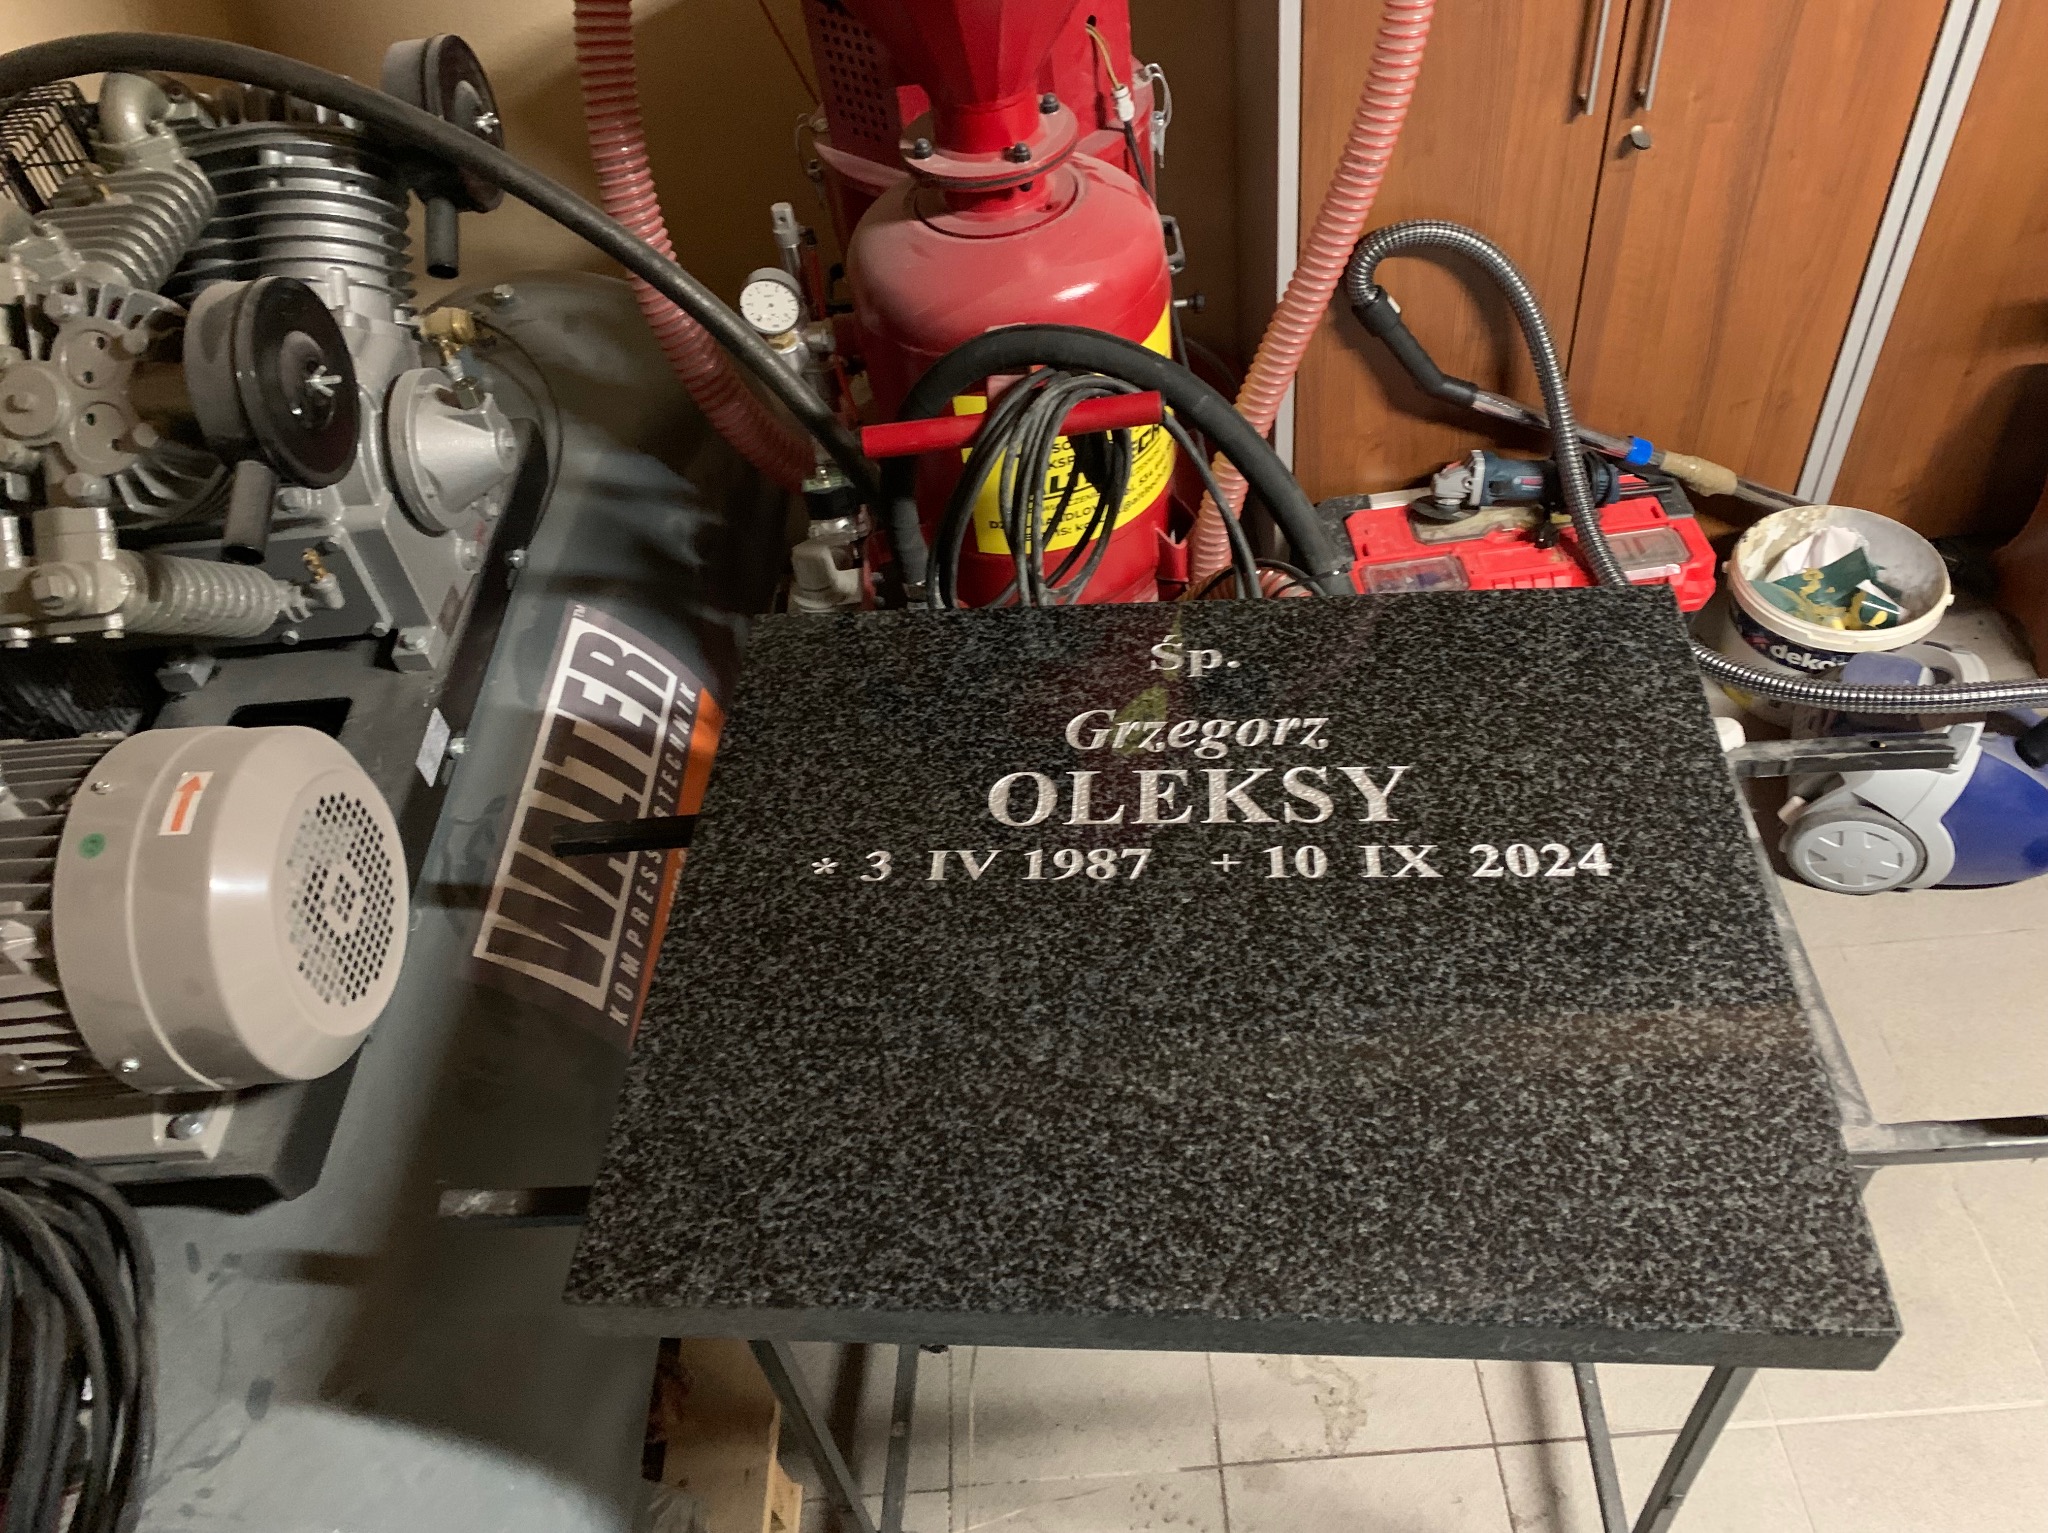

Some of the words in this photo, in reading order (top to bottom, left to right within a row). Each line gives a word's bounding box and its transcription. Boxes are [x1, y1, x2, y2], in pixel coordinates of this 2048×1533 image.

[1149, 634, 1241, 678] Śp.
[1769, 644, 1849, 671] deko
[1064, 708, 1330, 760] Grzegorz
[482, 626, 676, 992] WALTER
[987, 764, 1411, 827] OLEKSY
[608, 681, 698, 1027] KOMPRESSRTECHNIK
[859, 850, 893, 883] 3
[925, 849, 1001, 882] IV
[1021, 847, 1152, 881] 1987
[1263, 844, 1328, 880] 10
[1359, 843, 1440, 880] IX
[1471, 841, 1612, 879] 2024
